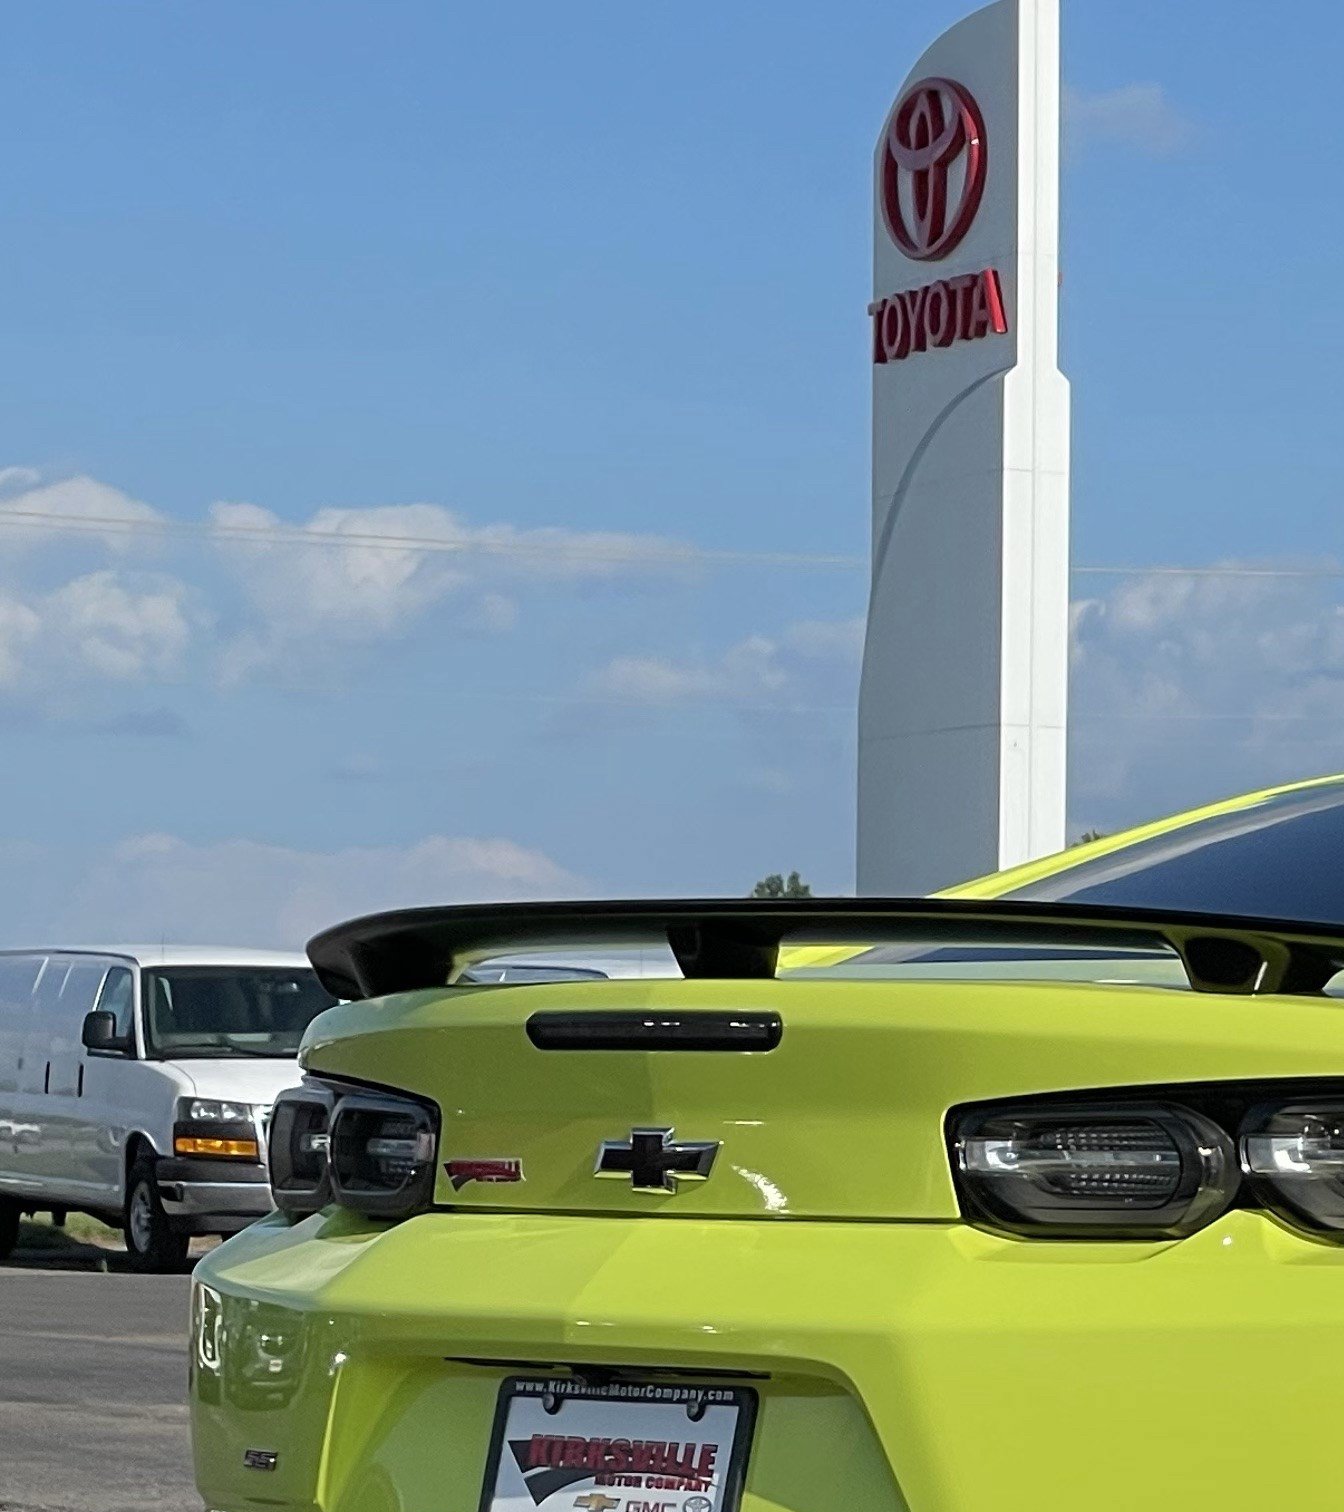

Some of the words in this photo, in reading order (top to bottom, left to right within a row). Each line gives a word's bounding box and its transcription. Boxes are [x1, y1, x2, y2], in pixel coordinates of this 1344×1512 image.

[867, 266, 1007, 364] TOYOTA
[244, 1450, 278, 1471] SS
[528, 1433, 719, 1478] KIRKSVILLE
[595, 1474, 642, 1488] MOTOR
[645, 1475, 712, 1492] COMPANY
